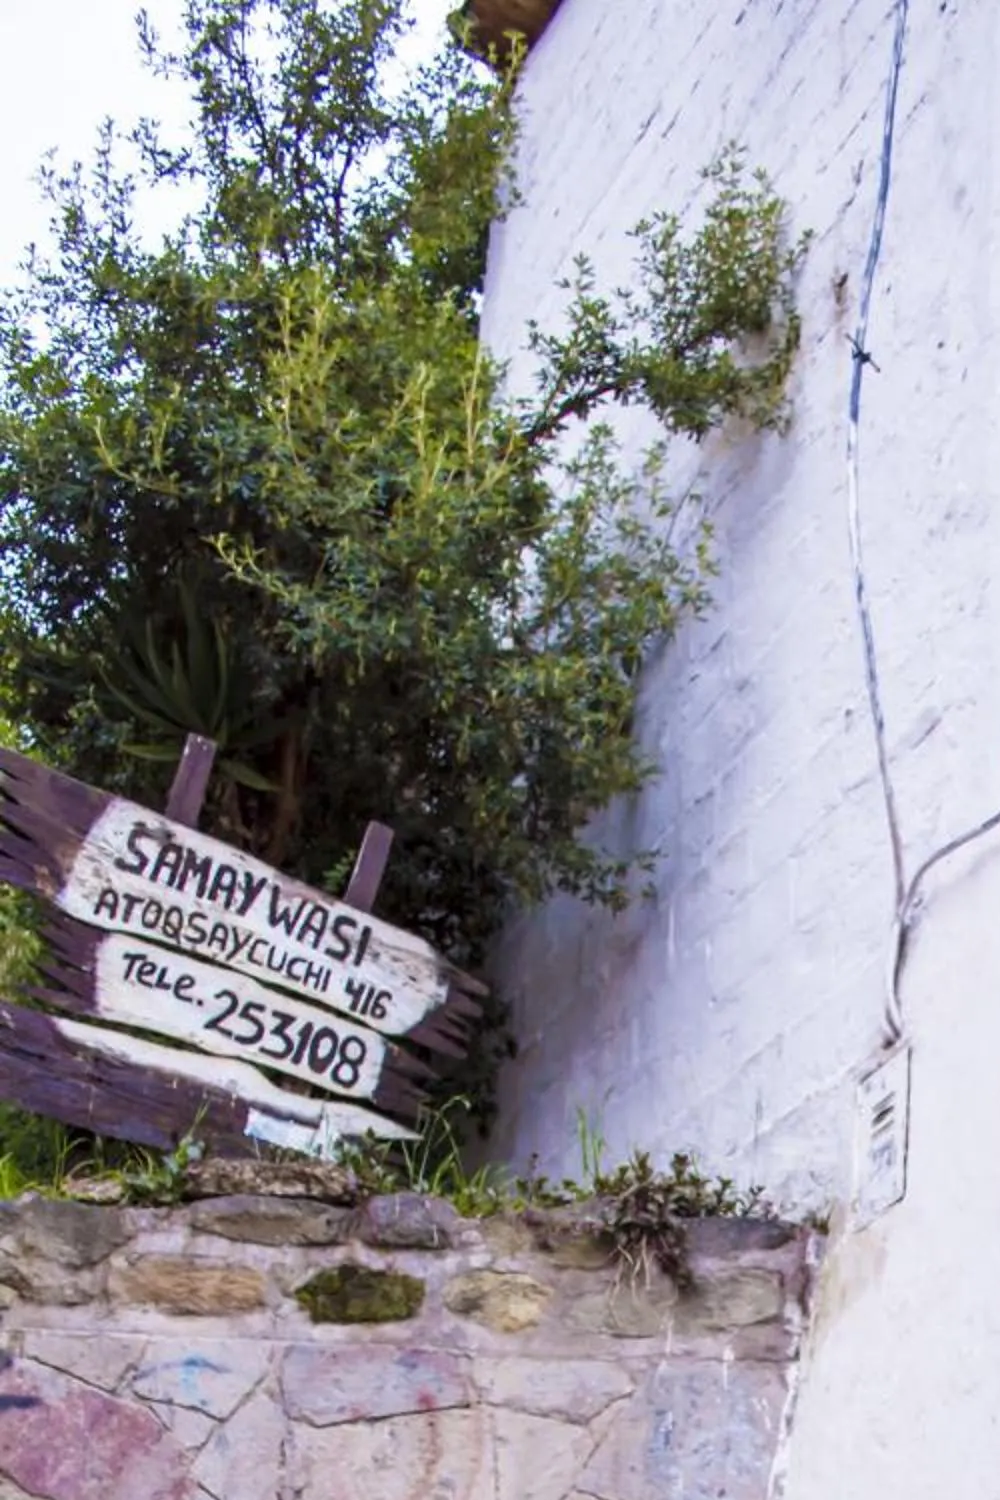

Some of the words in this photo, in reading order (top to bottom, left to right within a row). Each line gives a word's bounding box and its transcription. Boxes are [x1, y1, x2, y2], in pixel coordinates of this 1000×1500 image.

[93, 888, 333, 993] ATOQSAYCUCHI
[344, 976, 394, 1020] 416
[203, 988, 367, 1089] 253108
